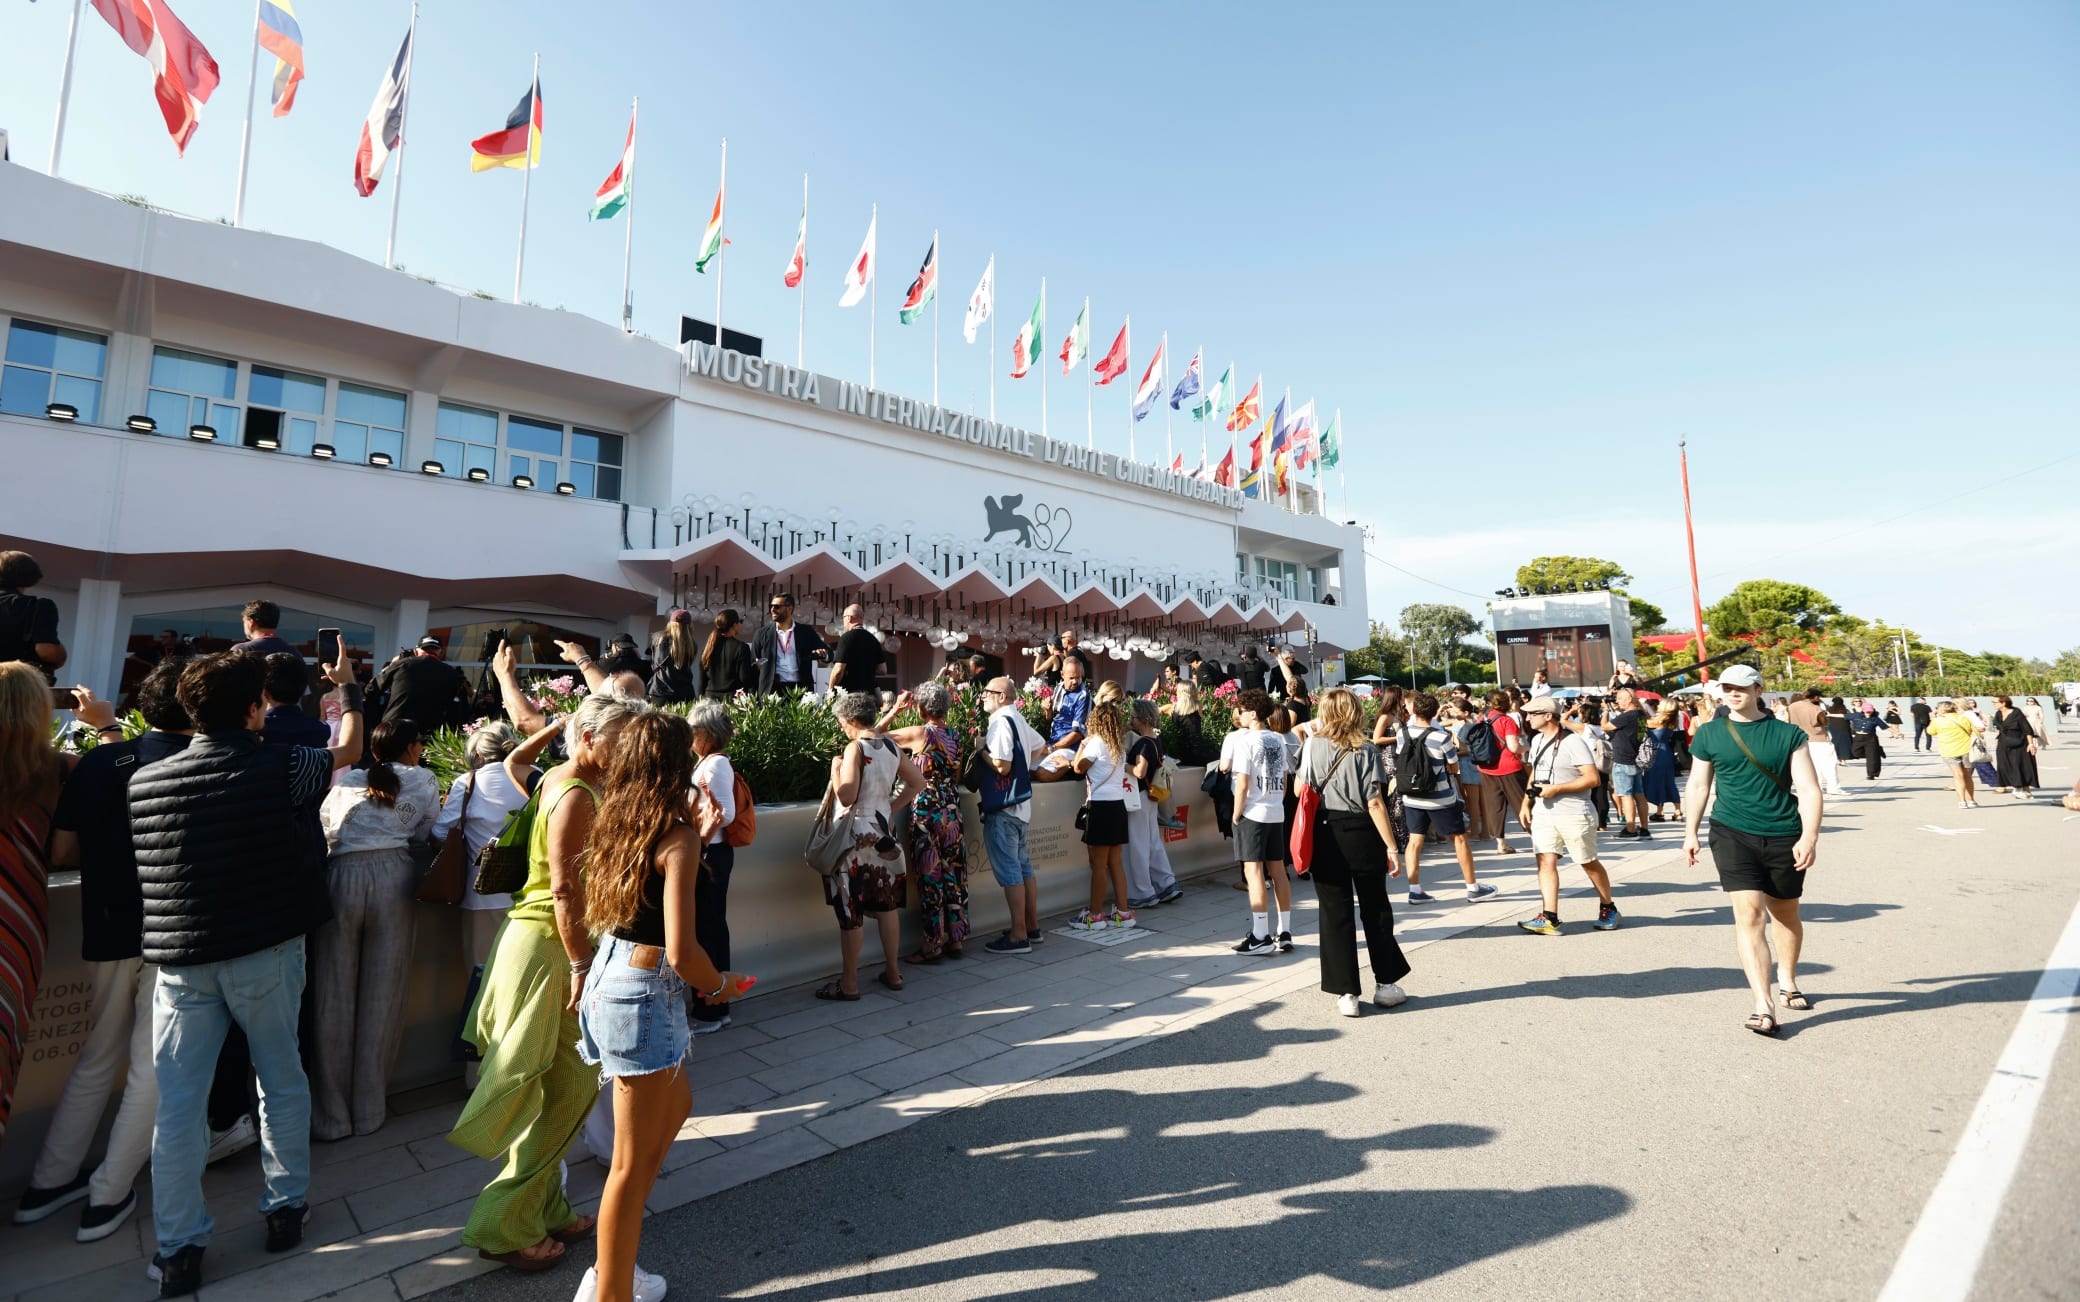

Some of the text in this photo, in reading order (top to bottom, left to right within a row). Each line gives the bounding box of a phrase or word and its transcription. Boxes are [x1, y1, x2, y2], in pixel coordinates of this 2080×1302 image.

[689, 340, 1246, 510] MOSTRA INTERNAZIONALE D'ARTE CINEMATOGRAFICA
[1033, 503, 1072, 554] 82
[32, 1040, 87, 1062] 06.0
